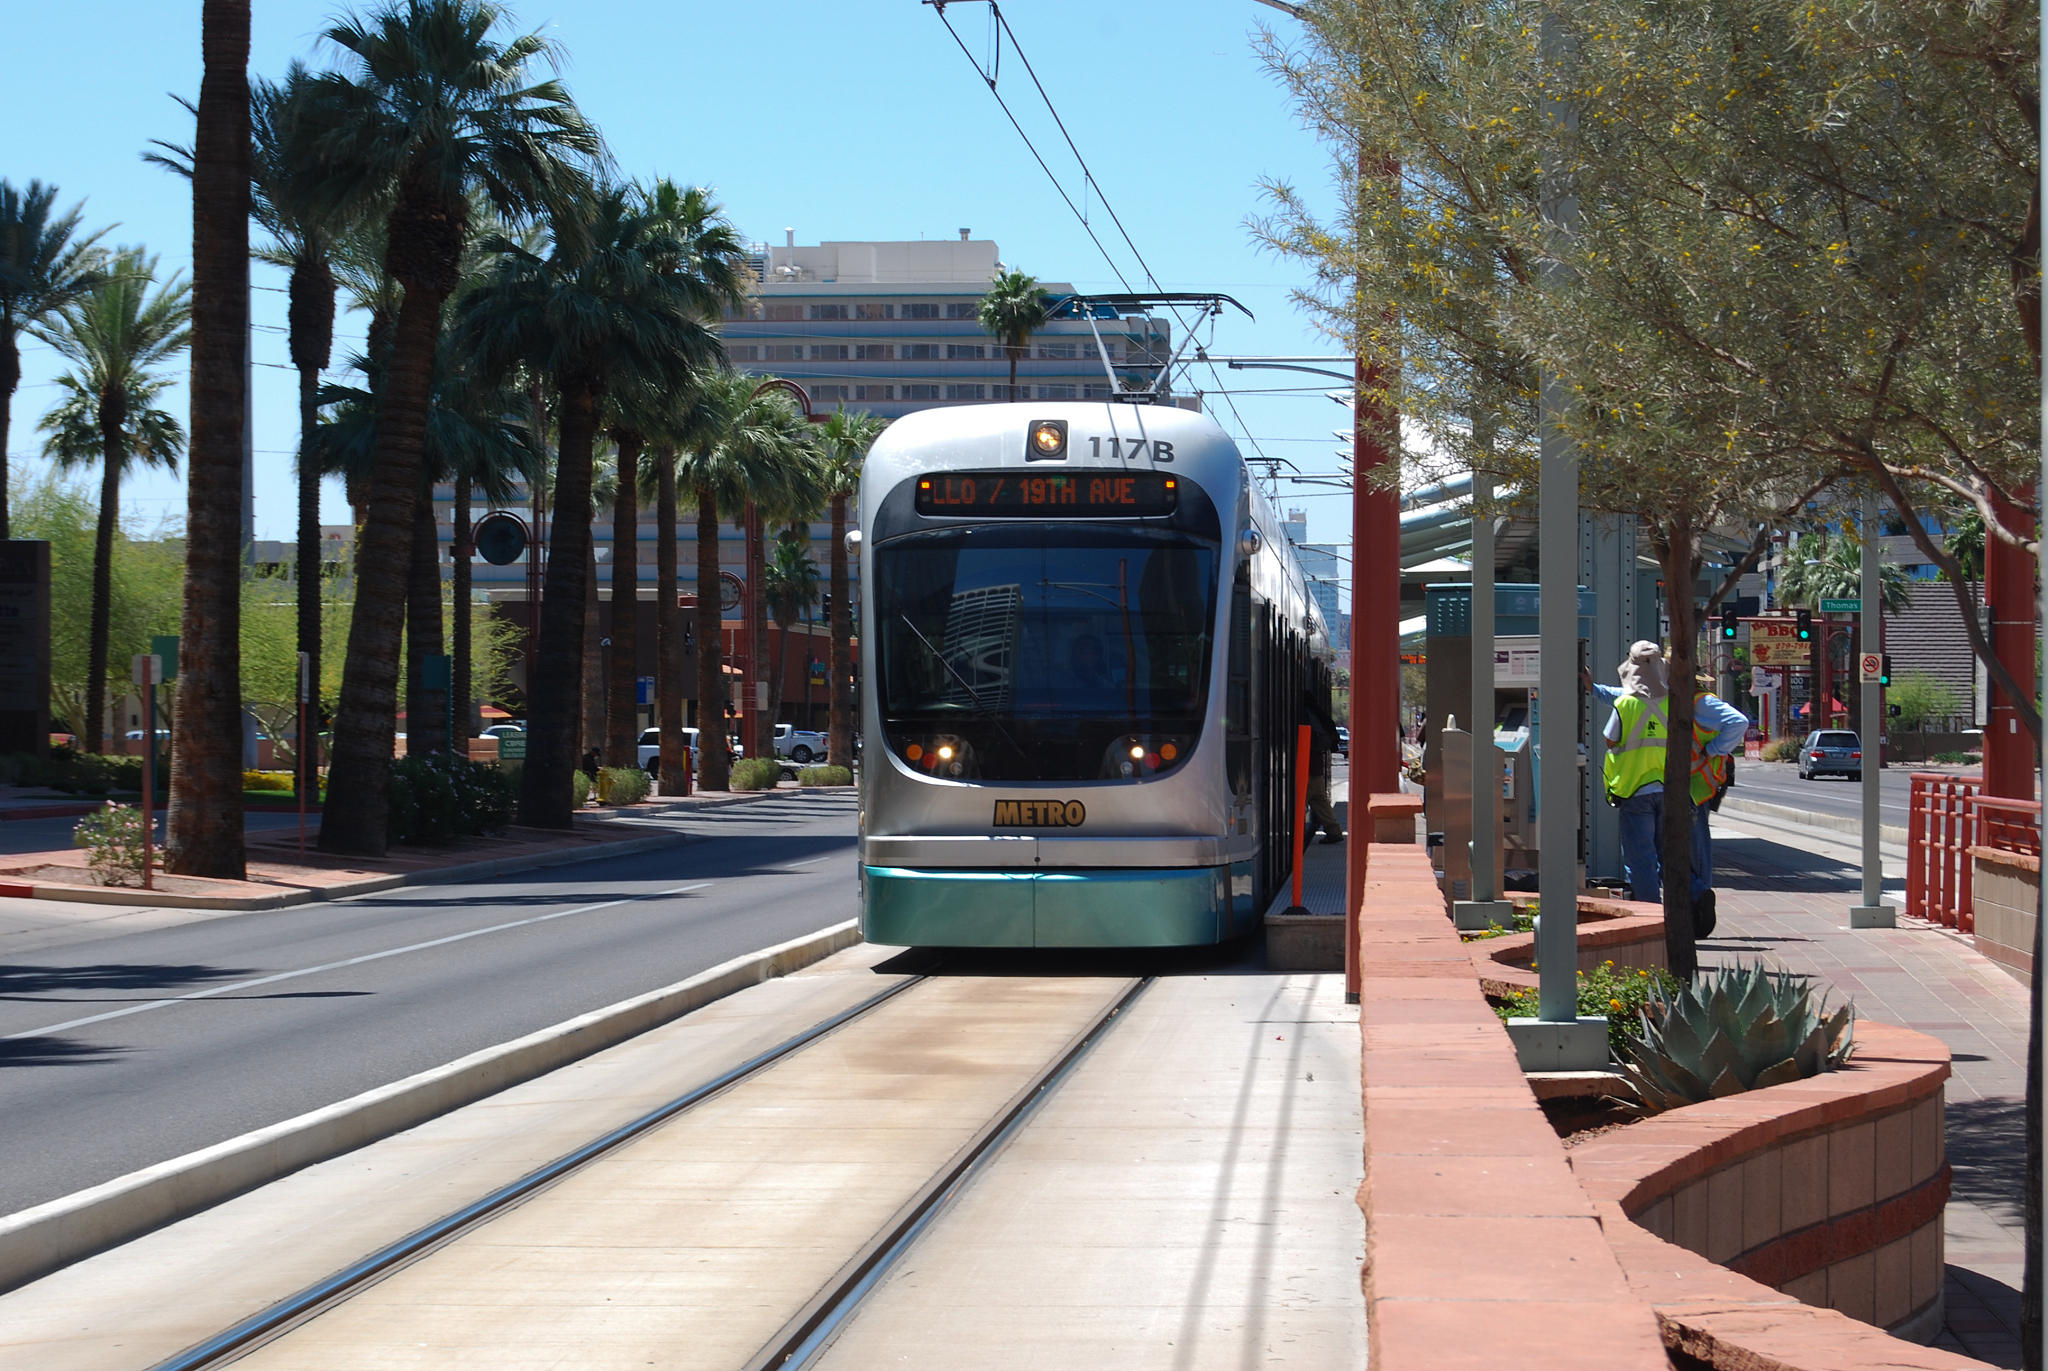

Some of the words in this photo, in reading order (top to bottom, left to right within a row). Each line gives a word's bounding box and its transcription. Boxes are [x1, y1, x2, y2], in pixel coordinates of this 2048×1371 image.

[1088, 435, 1175, 463] 117B
[933, 479, 976, 505] LLO
[990, 479, 1004, 504] /
[1020, 478, 1076, 504] 19TH
[1090, 478, 1136, 504] AVE
[1826, 601, 1858, 609] Thomas
[995, 801, 1085, 826] METRO
